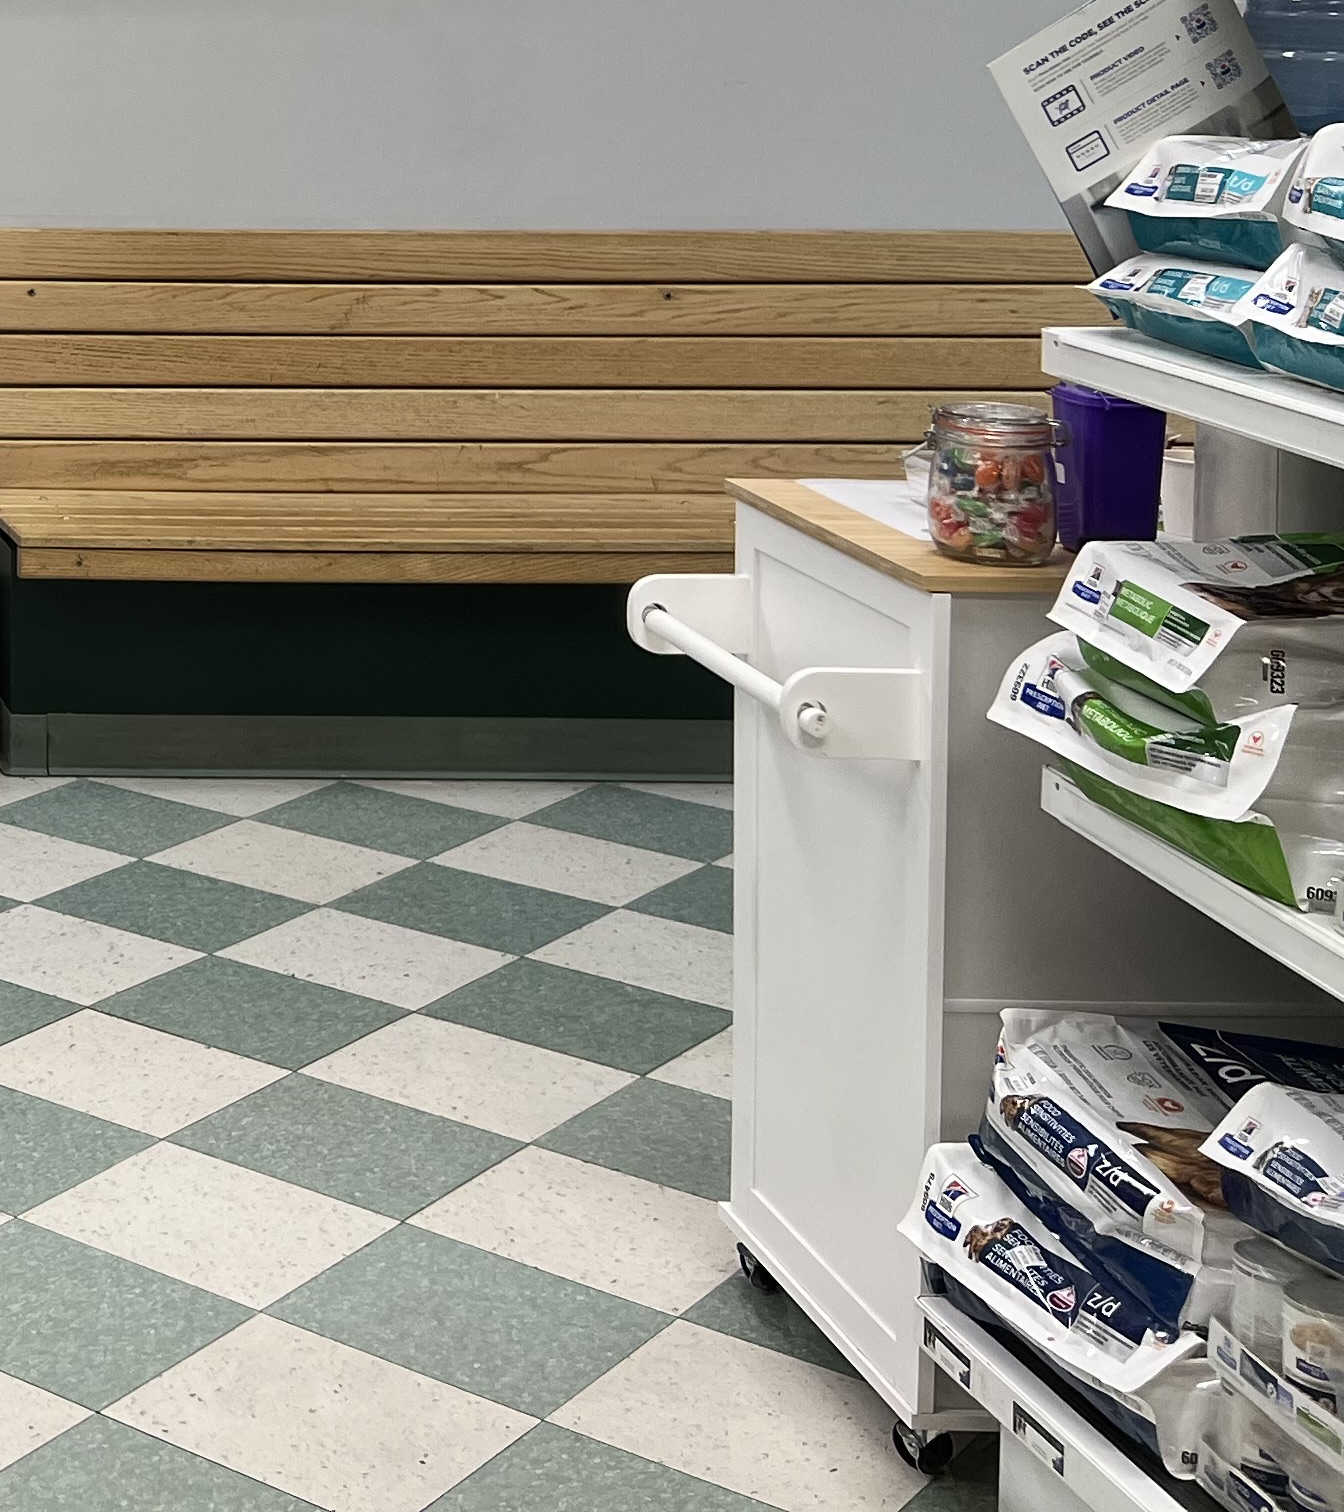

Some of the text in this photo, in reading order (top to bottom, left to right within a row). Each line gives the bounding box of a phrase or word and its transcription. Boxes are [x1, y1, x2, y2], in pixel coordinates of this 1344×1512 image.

[1022, 54, 1050, 76] SCAN
[1048, 43, 1069, 61] THE
[1068, 28, 1099, 49] CODE,
[1096, 15, 1116, 32] SEE
[1114, 4, 1135, 21] THE
[1089, 45, 1146, 82] PRODUCT VIDEO
[1113, 77, 1190, 125] PRODUCT DETAIL PAGE
[1189, 1042, 1268, 1085] z/d
[1032, 1103, 1076, 1145] SENSITIVITIES
[1038, 1099, 1062, 1118] FOOD
[1017, 1122, 1067, 1169] ALIMENTAIRES
[1019, 1113, 1064, 1155] SENSIBILITÉS
[1086, 1291, 1122, 1319] z/d
